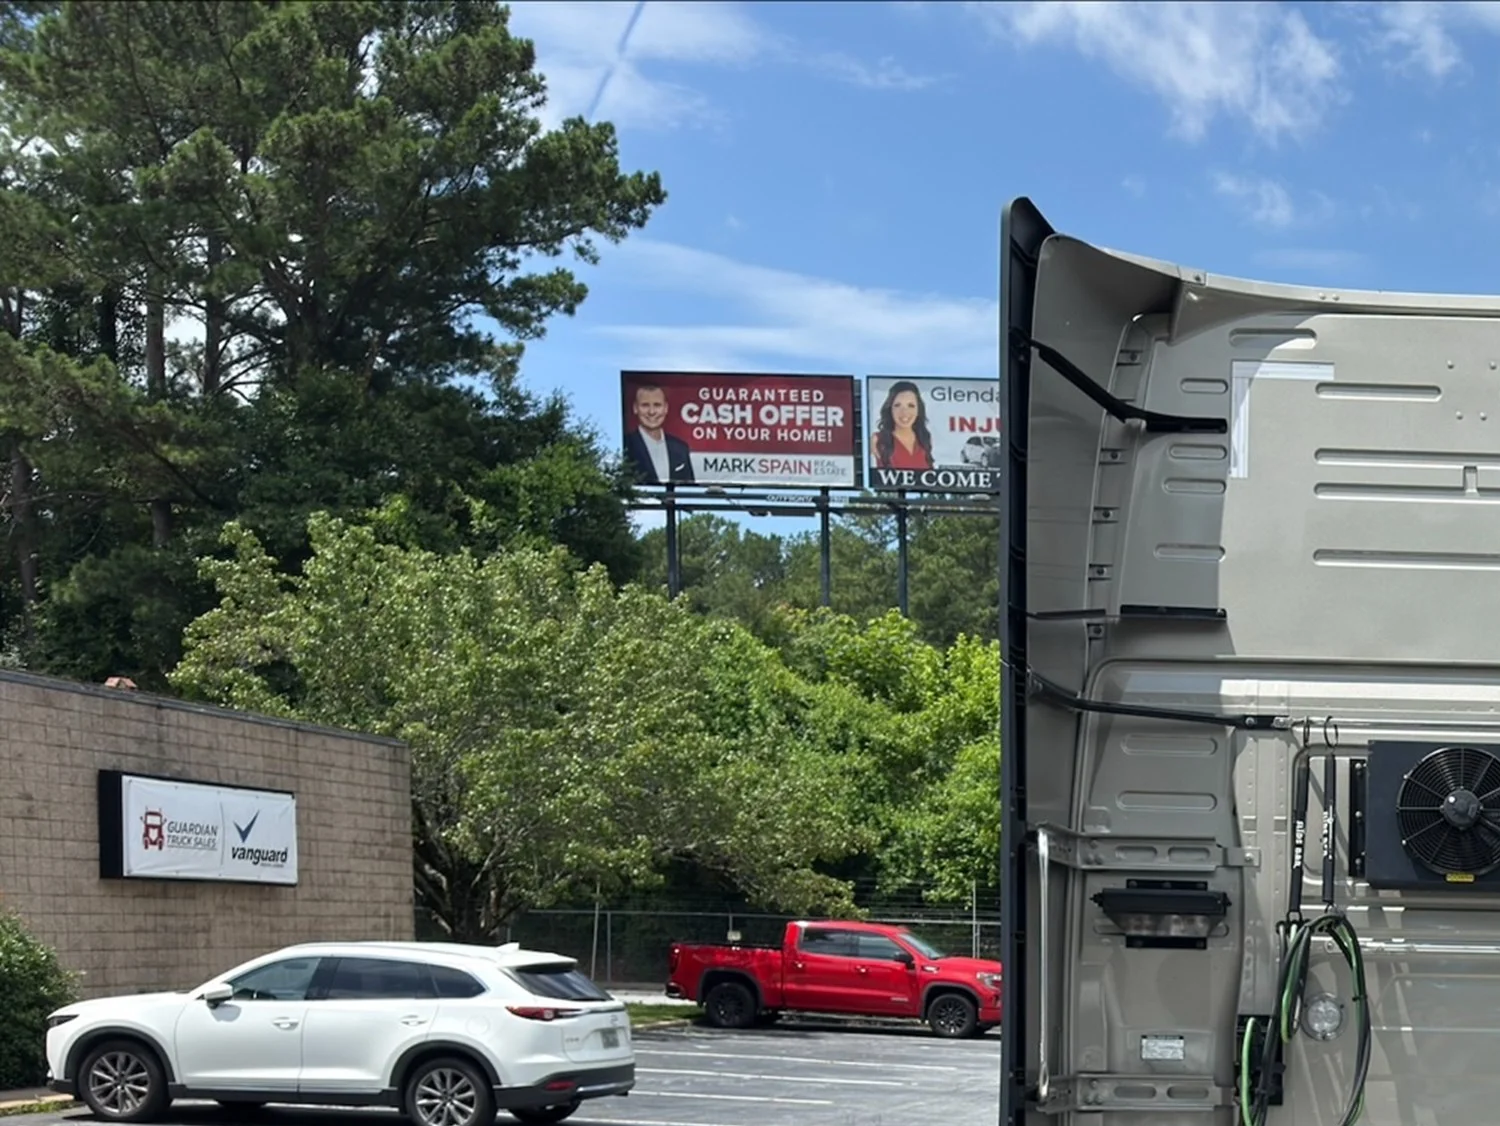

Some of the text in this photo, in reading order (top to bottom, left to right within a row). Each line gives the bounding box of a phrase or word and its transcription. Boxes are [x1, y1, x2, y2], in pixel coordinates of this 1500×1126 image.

[698, 387, 824, 403] GUARANTEED
[931, 386, 1000, 403] Glend
[680, 402, 844, 427] CASH OFFER
[692, 427, 832, 443] ON YOUR HOME!
[703, 457, 811, 475] MARK SPAIN
[814, 460, 836, 468] REAL
[814, 467, 847, 476] ESTATE
[878, 470, 993, 488] WE COME
[167, 820, 218, 836] GUARDIAN
[167, 834, 217, 849] TRUCK SALES
[231, 846, 288, 865] vanguard
